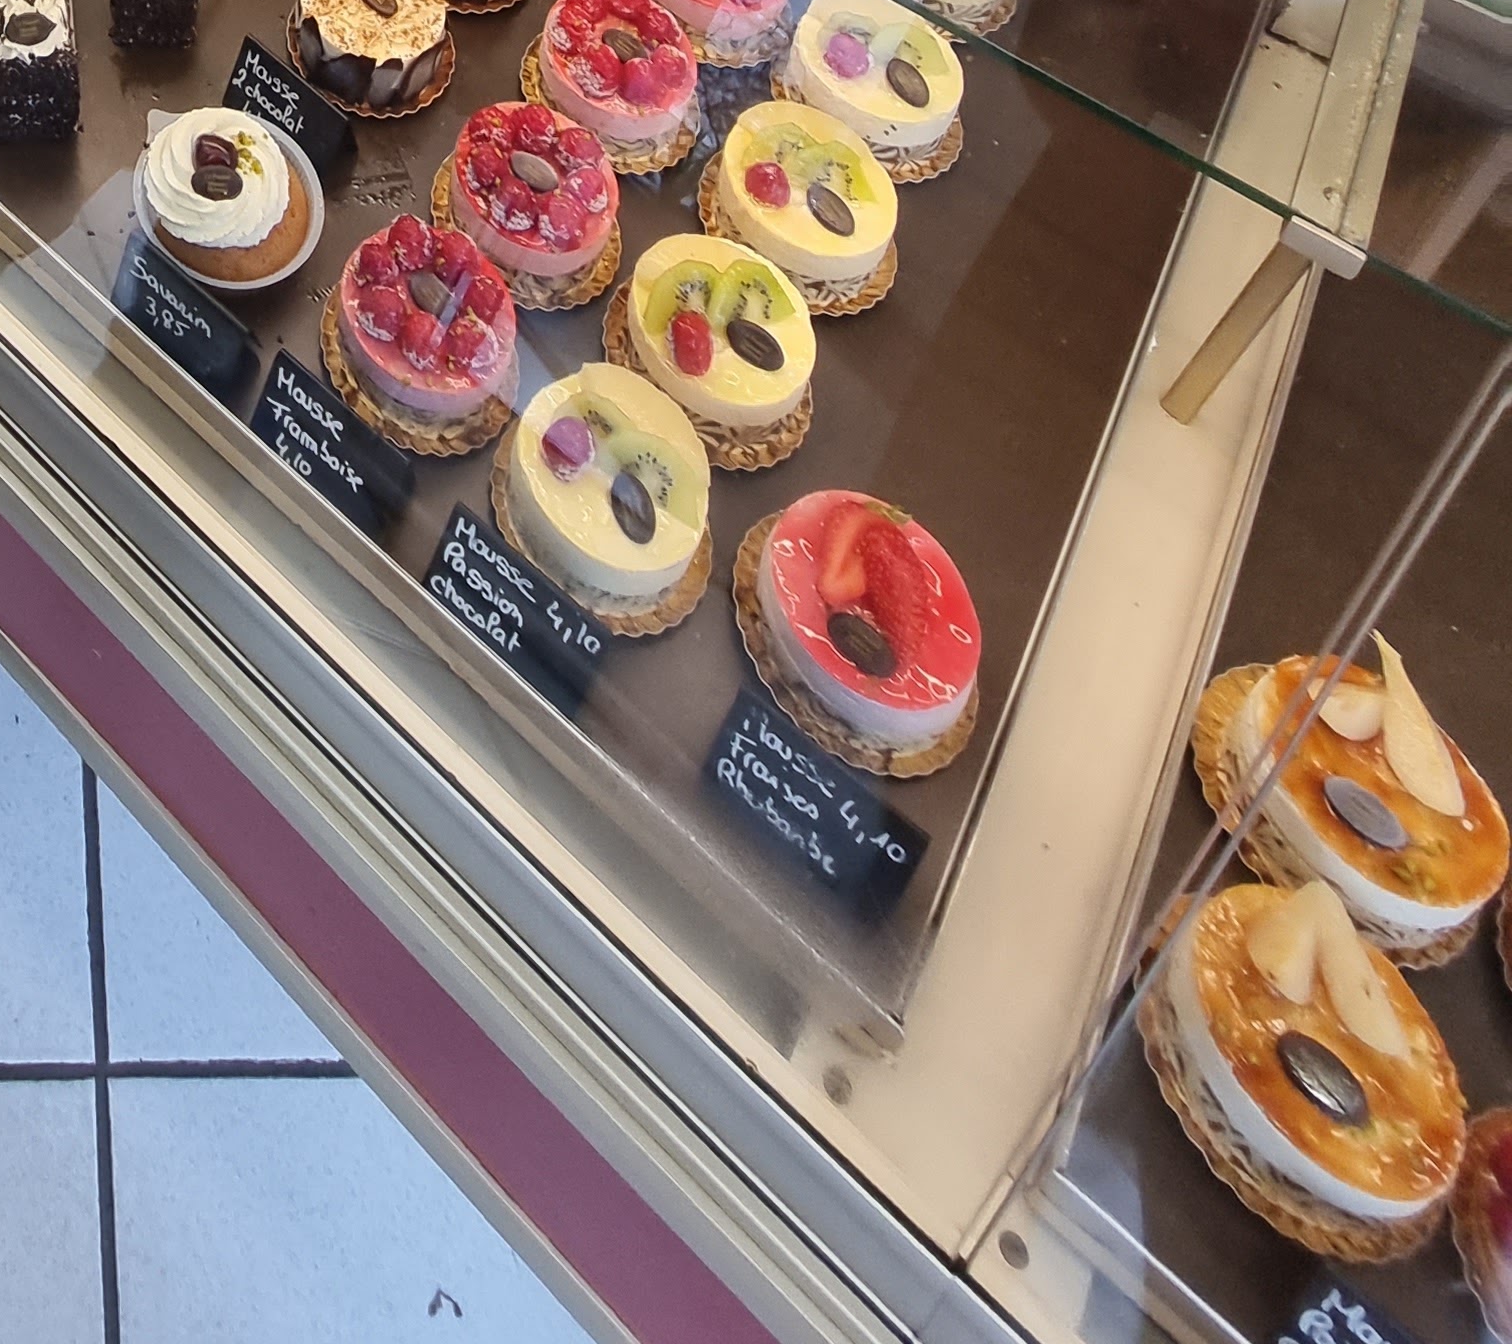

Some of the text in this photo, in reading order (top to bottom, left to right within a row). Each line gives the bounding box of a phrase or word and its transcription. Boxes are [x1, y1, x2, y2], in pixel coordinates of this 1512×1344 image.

[231, 67, 248, 89] 2
[244, 82, 305, 134] chocolat
[244, 49, 300, 110] Mousse
[128, 253, 212, 339] Savarin
[145, 295, 191, 337] 3,85
[276, 366, 345, 443] Mousse
[265, 395, 364, 494] Framboise
[429, 574, 522, 653] chocolat
[443, 541, 524, 630] Passion
[454, 516, 602, 655] Mousse 4,10
[839, 799, 907, 864] 4,10
